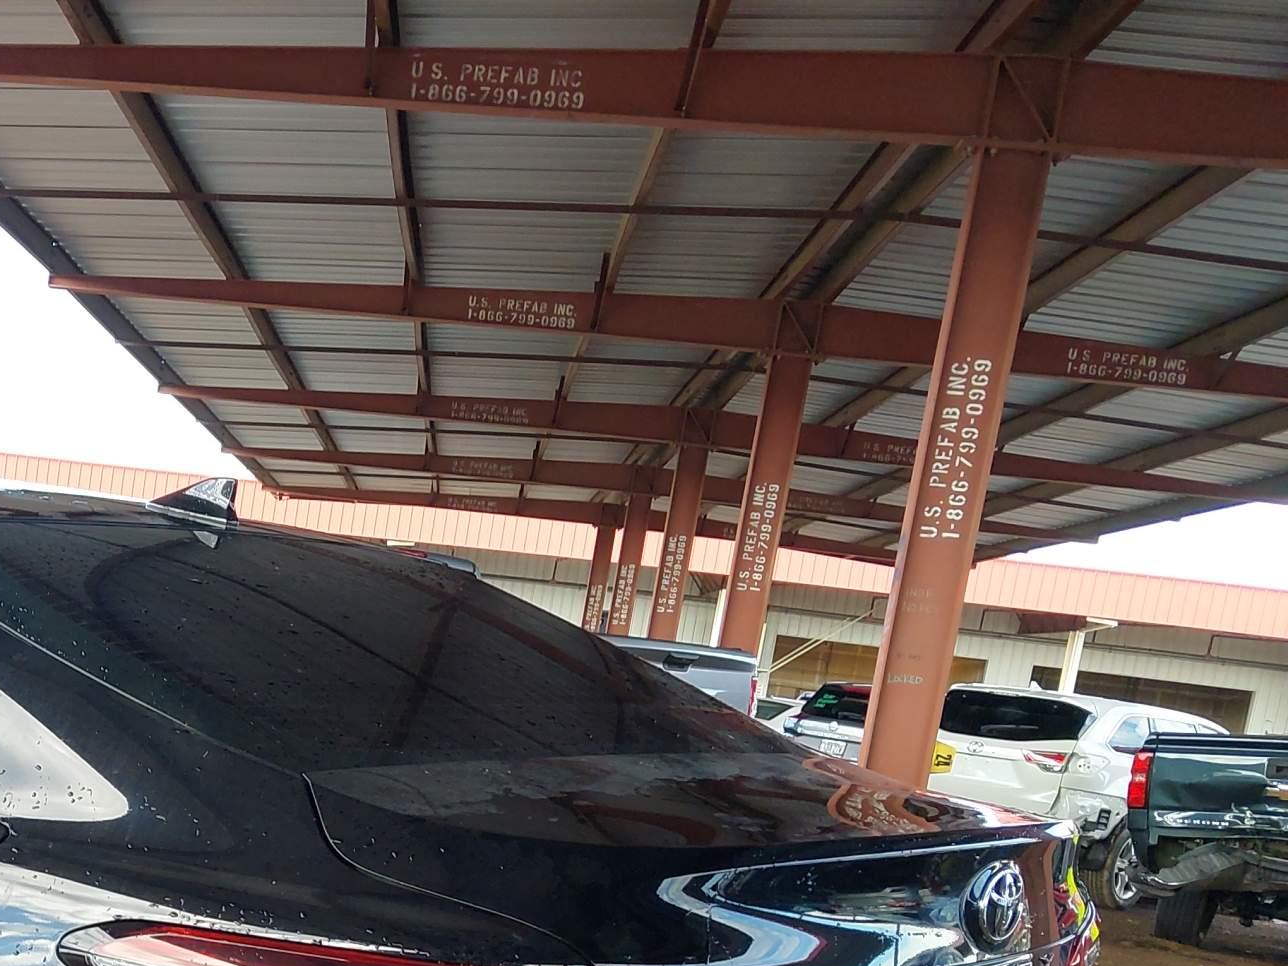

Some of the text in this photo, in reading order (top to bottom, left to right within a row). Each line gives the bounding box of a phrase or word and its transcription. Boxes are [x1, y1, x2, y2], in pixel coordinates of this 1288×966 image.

[460, 63, 540, 85] PREFAB
[411, 83, 585, 110] 1-866-799-0969
[467, 308, 576, 330] 1-866-799-0969
[498, 298, 548, 314] PREFAB
[553, 303, 577, 317] INC.
[1066, 361, 1187, 385] 1-866-799-0969
[1102, 351, 1157, 368] PREFAB
[919, 356, 972, 538] U.S. PREFAB INC.
[941, 359, 993, 539] 1-866-799-0969
[736, 482, 768, 592] U.S. PREFAB INC.
[749, 483, 780, 592] 1-866-799-0969
[660, 555, 674, 591] PREFAB
[614, 579, 626, 608] PREFAB
[934, 754, 953, 767] 24
